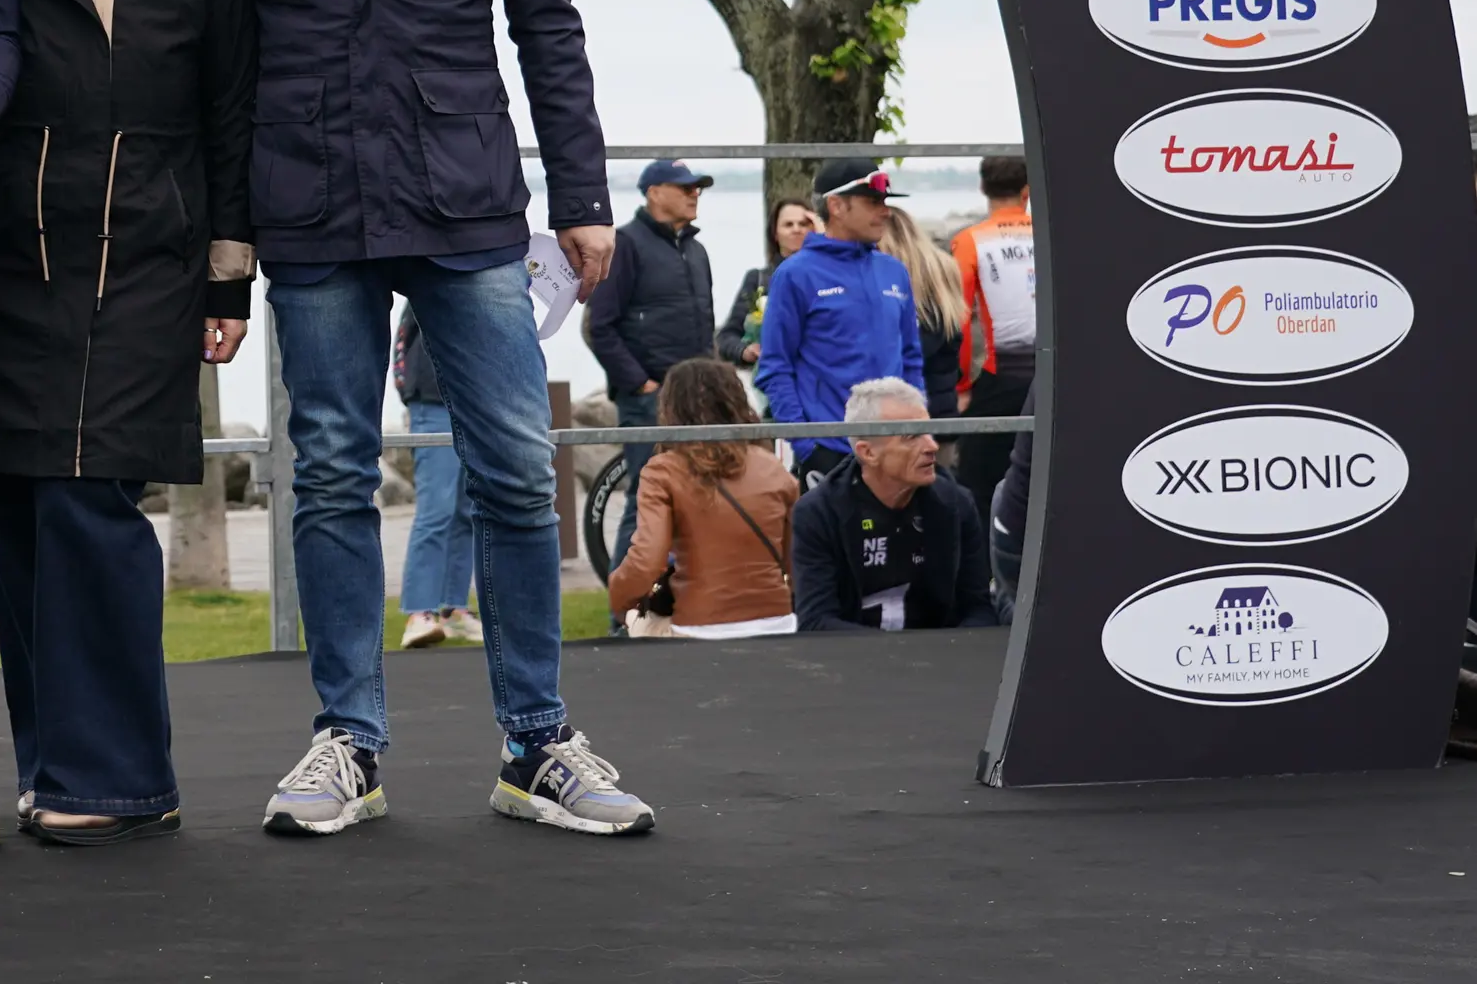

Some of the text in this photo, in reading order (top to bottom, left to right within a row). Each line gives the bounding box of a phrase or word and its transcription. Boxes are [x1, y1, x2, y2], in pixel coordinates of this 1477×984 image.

[1160, 132, 1355, 173] tomasi
[1299, 172, 1353, 183] AUTO
[1264, 291, 1378, 311] Poliambulatorio
[1277, 314, 1336, 334] Oberdan
[1176, 639, 1319, 667] CALEFFI
[1187, 668, 1310, 684] MY FAMILY, MY HOME
